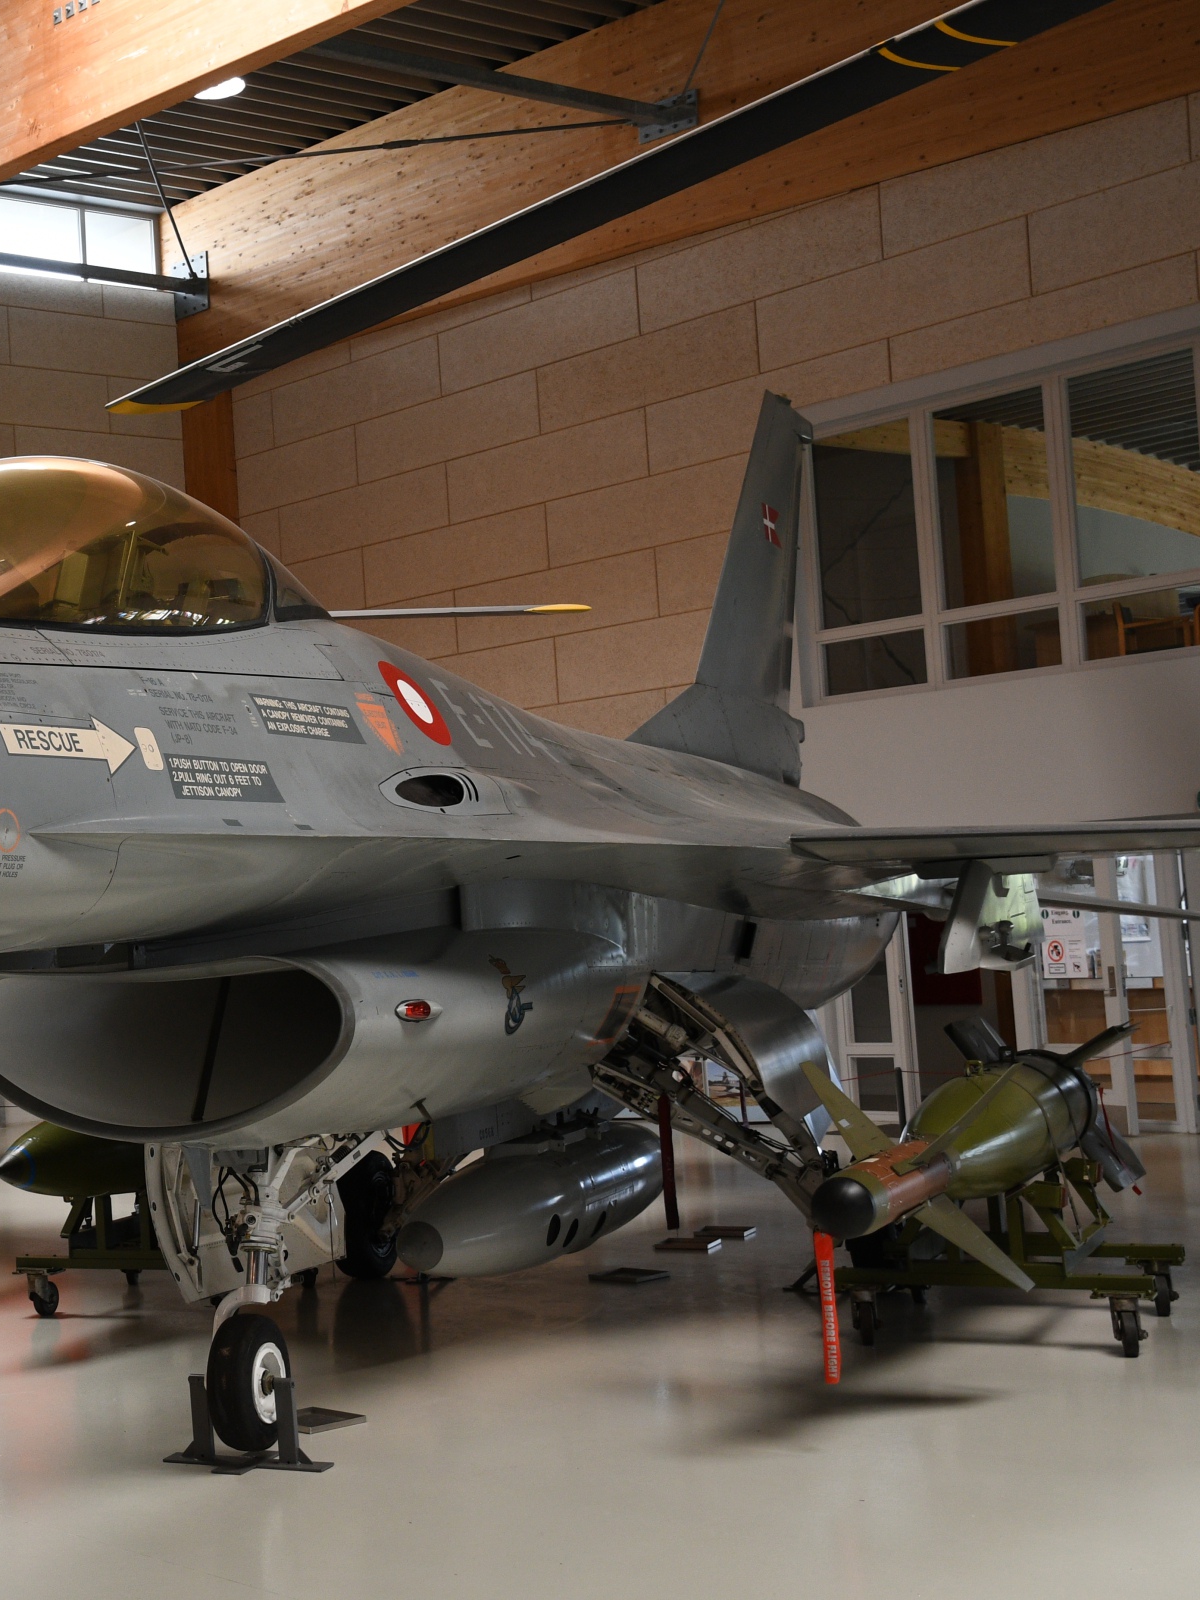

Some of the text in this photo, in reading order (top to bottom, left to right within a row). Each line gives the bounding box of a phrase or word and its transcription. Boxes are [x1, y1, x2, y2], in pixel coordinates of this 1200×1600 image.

[30, 646, 61, 655] SERIAL
[158, 678, 165, 686] A
[148, 689, 174, 699] SERIAL
[176, 692, 186, 700] NO.
[186, 692, 214, 703] 78-0174
[158, 706, 236, 722] SERVICE THIS AIRCRAFT
[282, 701, 297, 710] THIS
[297, 703, 323, 714] AIRCRAFT
[261, 709, 267, 717] A
[267, 710, 290, 720] CANOPY
[291, 713, 318, 724] REMOVER
[164, 720, 238, 736] WITH NATO CODE F-34
[267, 721, 276, 730] AN
[278, 722, 307, 734] EXPLOSIVE
[14, 728, 84, 752] RESCUE
[170, 732, 193, 745] (JP-8)
[169, 758, 268, 774] 1.PUSH BUTTON TO OPEN DOOR
[173, 771, 262, 786] 2.PULL RING OUT 6 FEET TO
[182, 786, 242, 797] JETTISON CANOPY
[820, 1260, 838, 1378] REMOVE BEFORE FLIGHT
